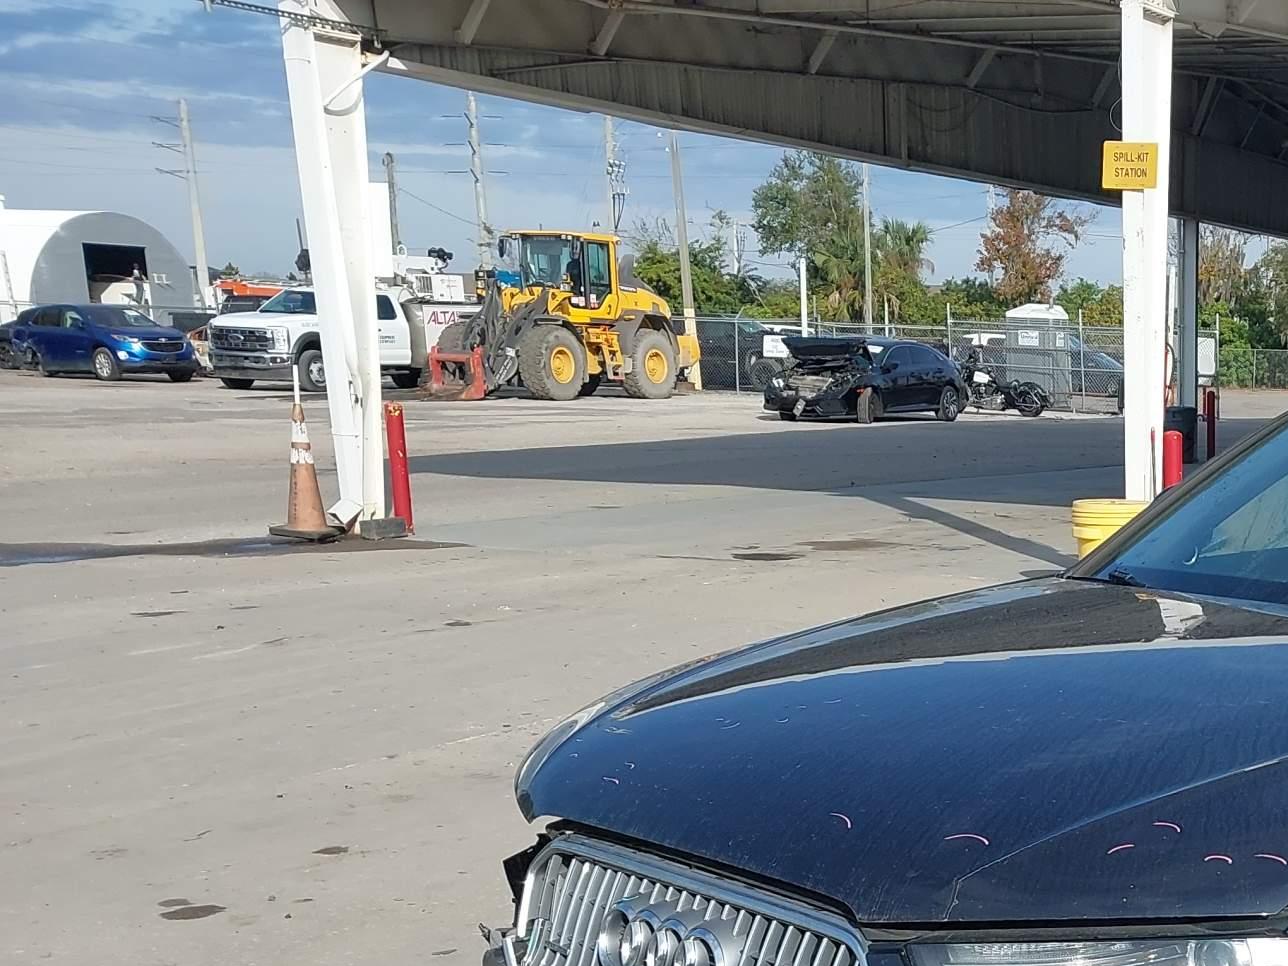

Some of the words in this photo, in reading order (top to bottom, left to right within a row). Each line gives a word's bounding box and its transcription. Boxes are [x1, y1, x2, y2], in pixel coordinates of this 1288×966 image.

[1113, 151, 1149, 162] SPILL-KIT
[1114, 167, 1147, 178] STATION
[427, 310, 456, 325] ALTA
